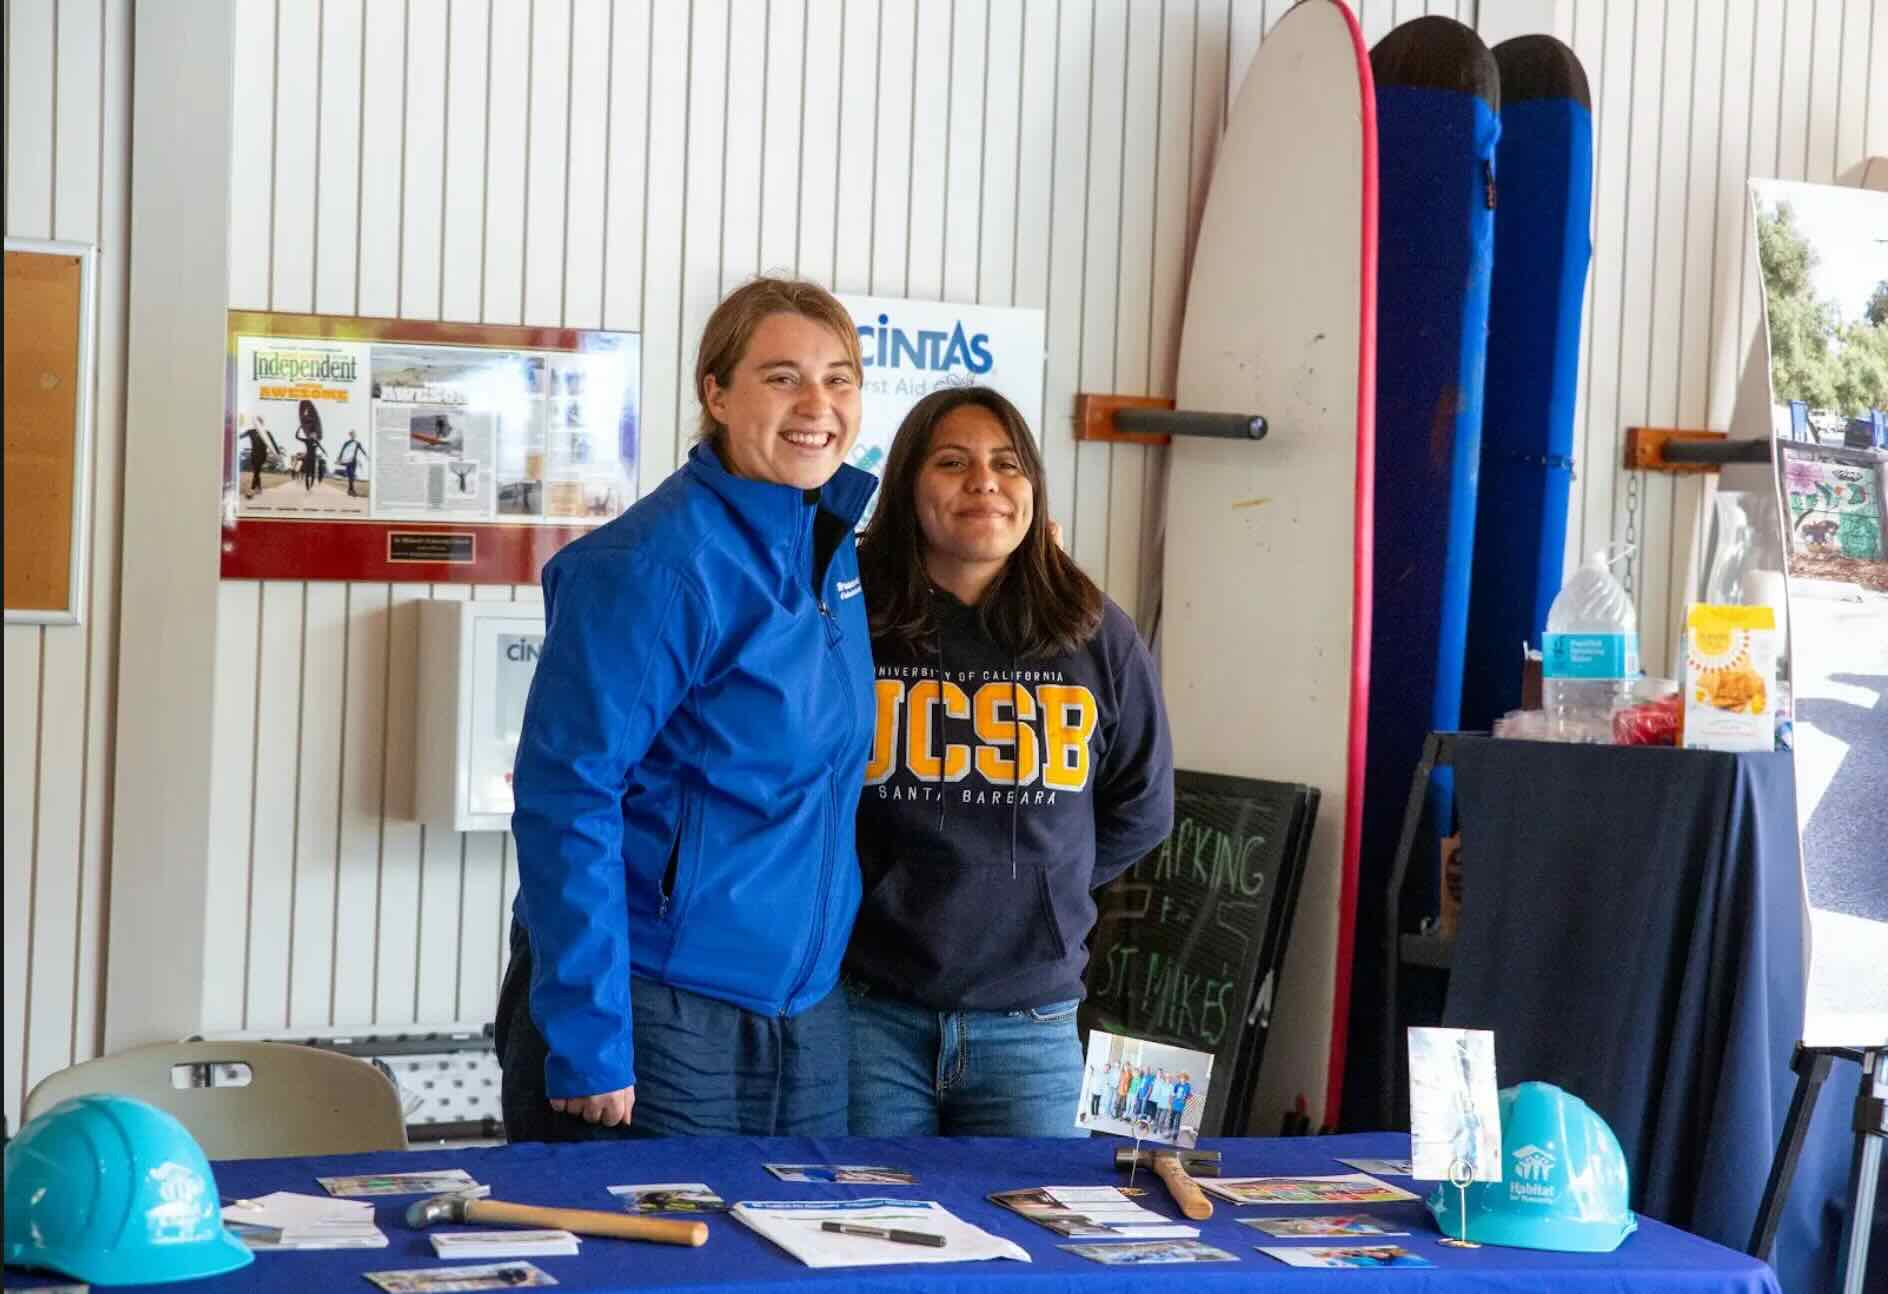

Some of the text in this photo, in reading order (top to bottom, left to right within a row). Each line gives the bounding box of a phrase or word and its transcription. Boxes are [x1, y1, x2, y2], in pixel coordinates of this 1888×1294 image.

[253, 351, 357, 382] Independent
[895, 378, 927, 396] Aid
[873, 665, 1064, 683] NIVERSIY OF CALIFORNIA
[962, 789, 1057, 805] BARBARA
[1510, 1181, 1553, 1196] Habitat
